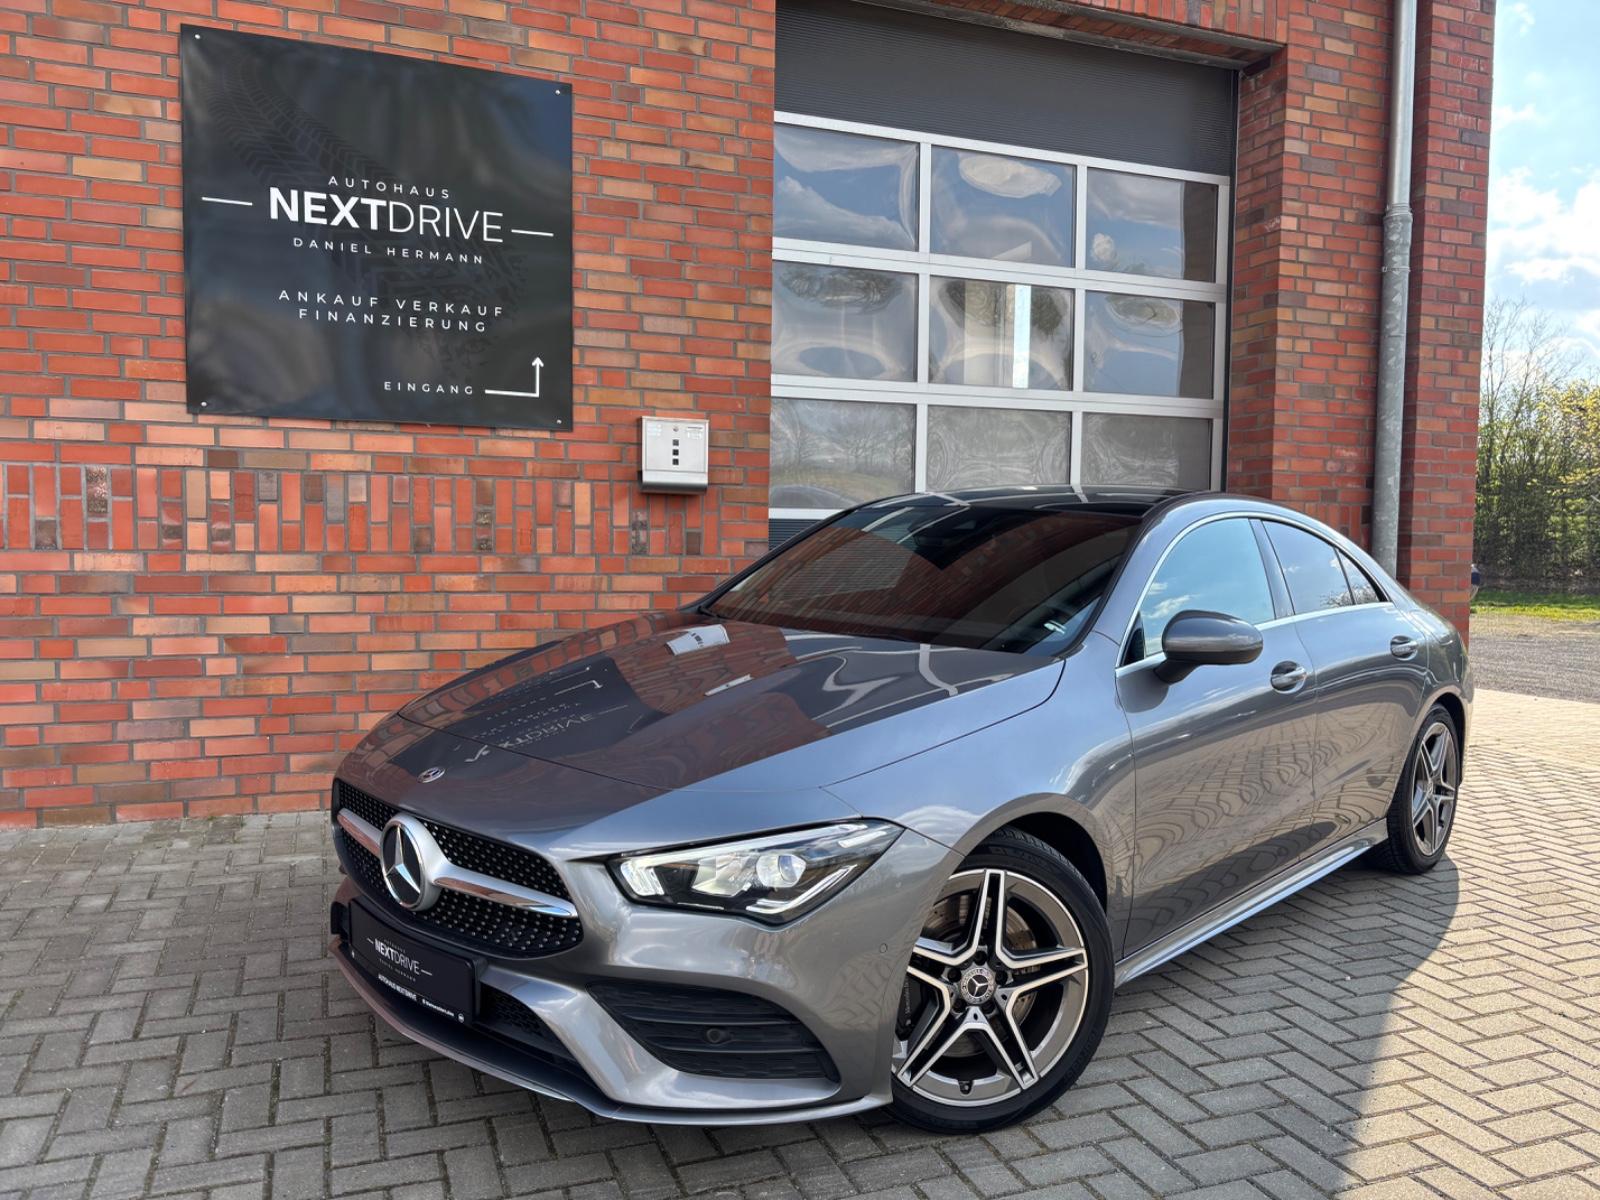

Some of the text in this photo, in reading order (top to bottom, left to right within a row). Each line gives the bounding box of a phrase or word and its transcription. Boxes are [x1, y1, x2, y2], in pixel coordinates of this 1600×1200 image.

[328, 175, 449, 200] AUTOHAUS
[269, 186, 504, 243] NEXTDRIVE
[293, 237, 482, 265] DANIEL HERMANN
[278, 289, 502, 317] ANKAUF VERKAUF
[298, 308, 485, 333] FINANZIERUNG
[383, 381, 473, 395] EINGANG
[374, 938, 420, 975] NEXTDRIVE
